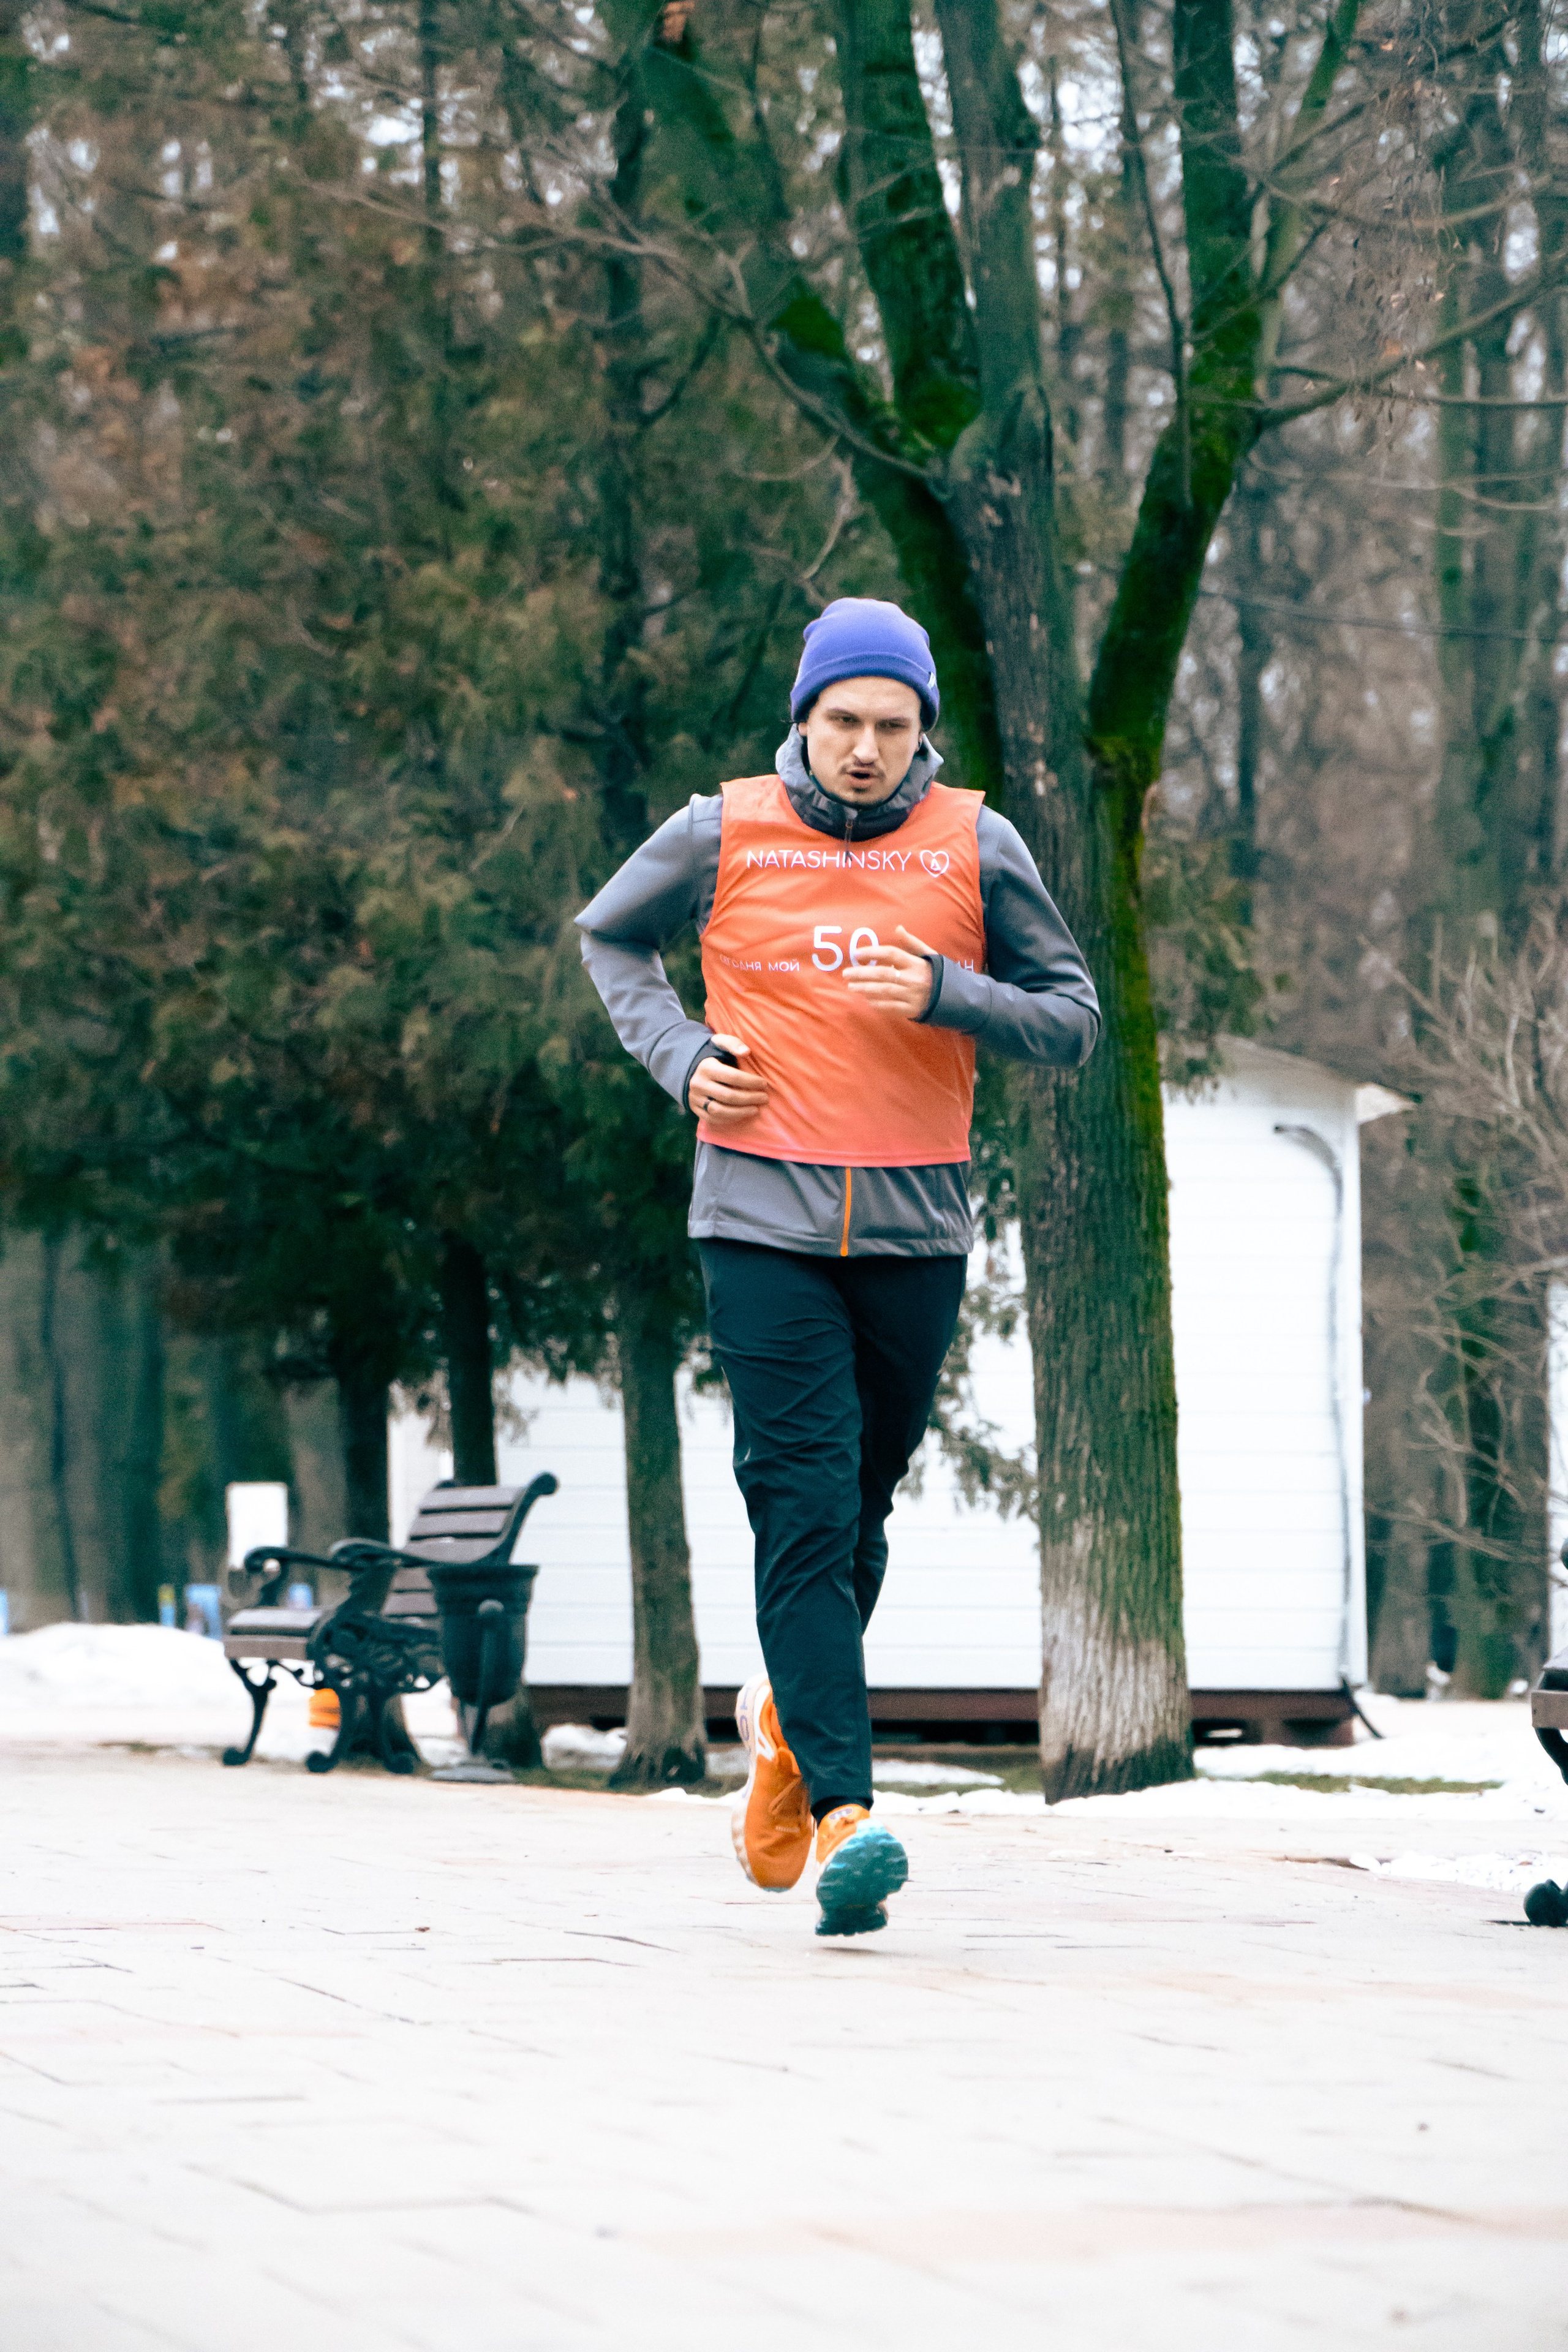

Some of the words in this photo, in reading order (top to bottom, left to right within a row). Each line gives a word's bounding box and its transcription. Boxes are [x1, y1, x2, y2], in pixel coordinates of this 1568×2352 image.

[747, 850, 911, 871] NATASHINSKY
[768, 959, 800, 971] МОЙ
[812, 925, 880, 972] 50
